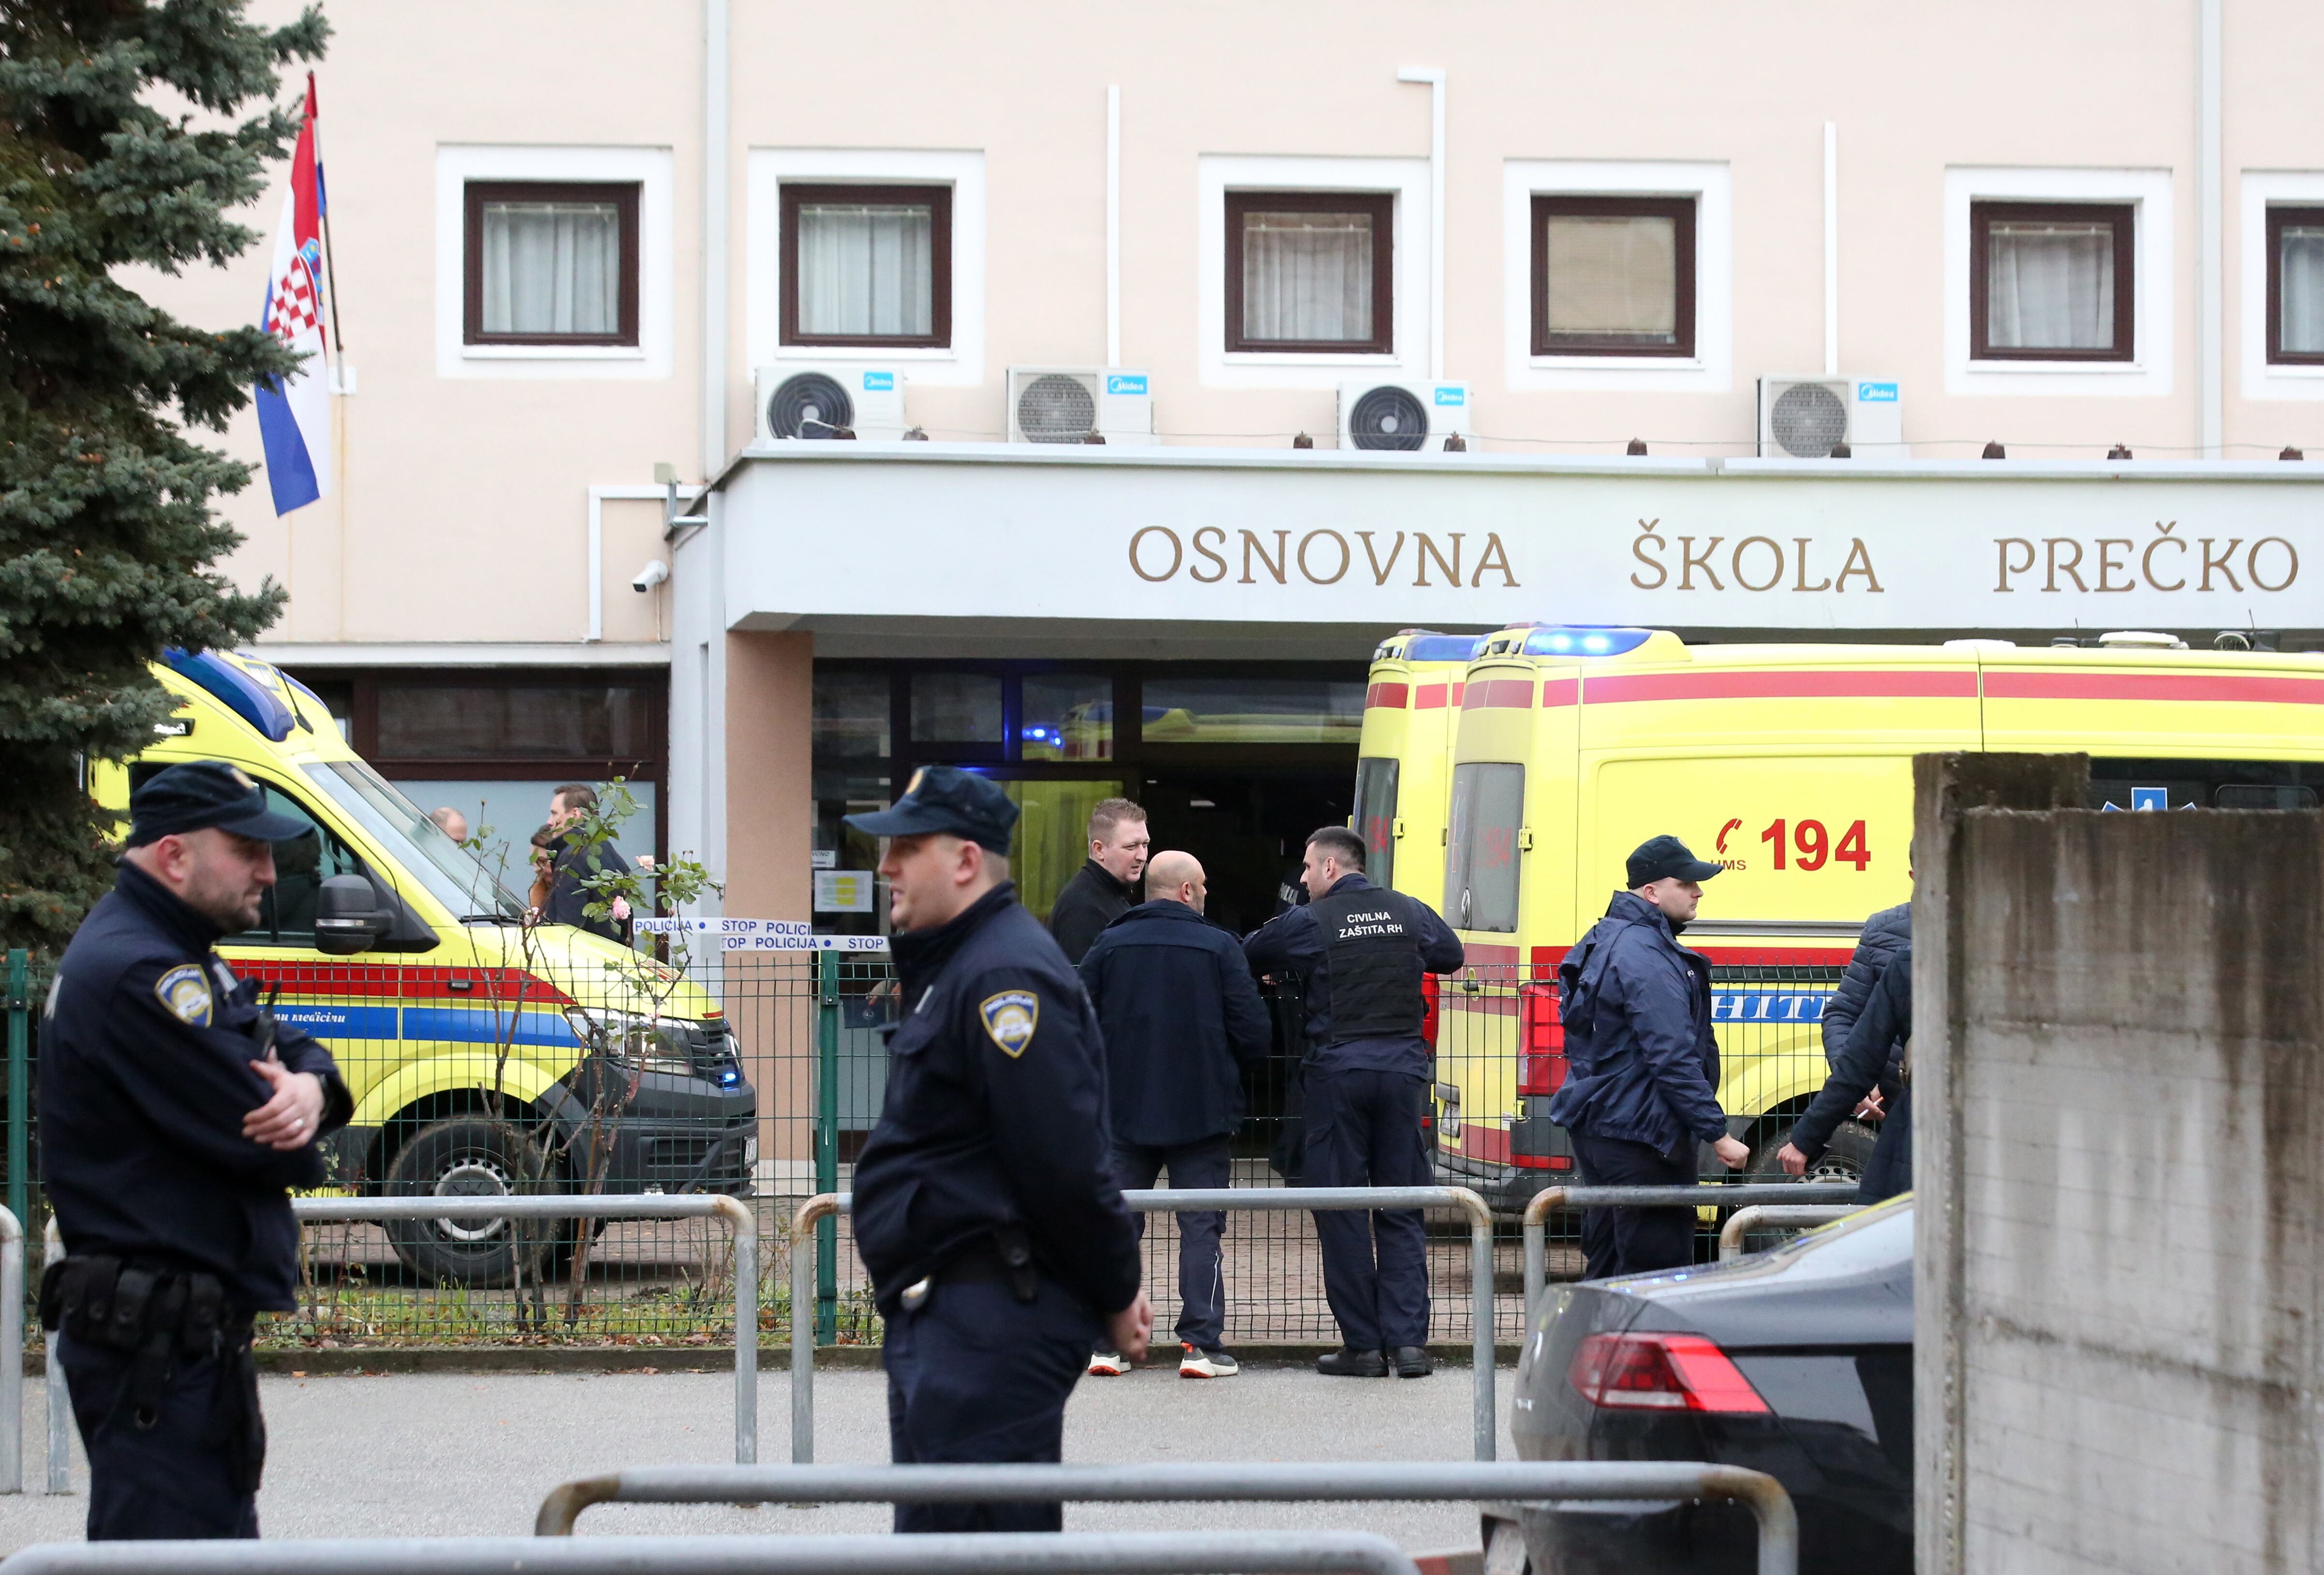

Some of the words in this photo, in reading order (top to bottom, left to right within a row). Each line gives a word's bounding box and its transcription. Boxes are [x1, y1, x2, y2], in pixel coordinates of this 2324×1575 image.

[1129, 525, 1521, 587] OSNOVNA
[1630, 518, 1884, 593] ŠKOLA
[1993, 520, 2299, 593] PREČKO
[1762, 818, 1871, 871] 194
[1347, 911, 1391, 923] CIVILNA
[635, 920, 693, 932] POLICIJA
[722, 920, 757, 932] STOP
[766, 922, 811, 936] POLICI
[1339, 925, 1386, 938] ZAŠTITA
[1387, 924, 1403, 934] RH
[756, 937, 817, 949] POLICIJA
[848, 938, 884, 949] STOP
[291, 1011, 346, 1023] medicinu
